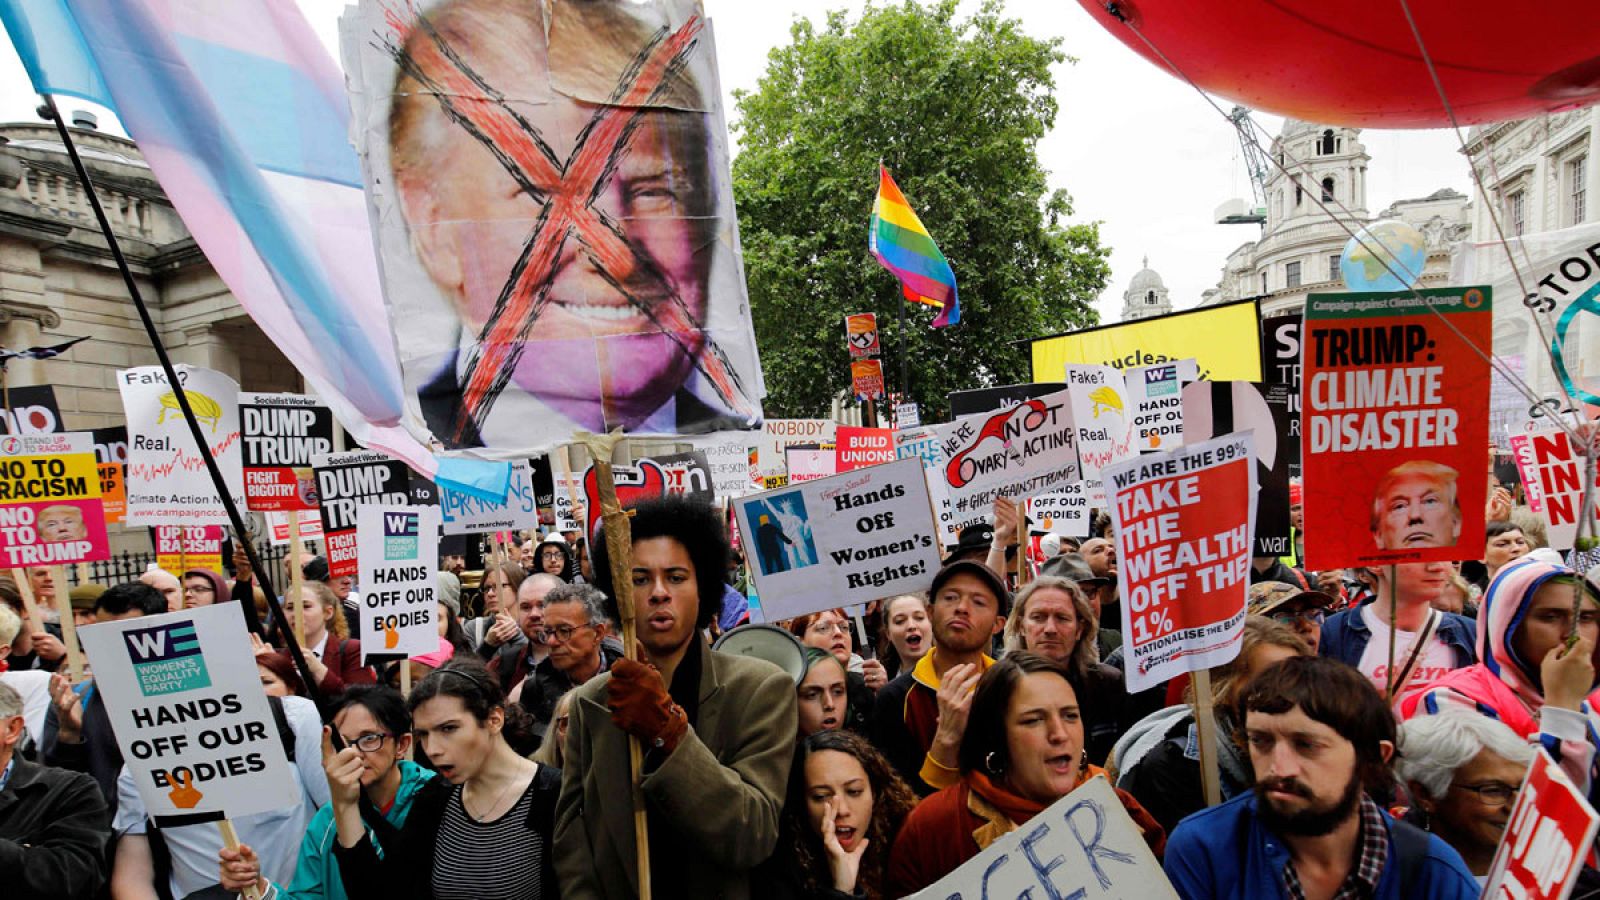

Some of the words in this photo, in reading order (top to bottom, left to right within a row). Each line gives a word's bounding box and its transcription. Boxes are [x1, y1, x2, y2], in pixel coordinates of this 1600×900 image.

[1313, 300, 1354, 312] Campaign
[1354, 299, 1388, 311] against
[1389, 297, 1425, 307] Climate
[1426, 295, 1462, 306] Change
[1312, 325, 1436, 368] TRUMP:
[1103, 349, 1178, 369] uclea
[125, 371, 188, 386] Fak?
[1069, 370, 1105, 385] Fake?
[1310, 366, 1443, 410] CLIMATE
[254, 396, 288, 405] Socialist
[289, 397, 316, 406] Worker
[1139, 398, 1183, 412] HAND
[243, 408, 316, 437] DUMP
[1134, 414, 1161, 426] OFF
[1165, 411, 1183, 422] OU
[766, 422, 825, 436] NOBODY
[1080, 428, 1112, 441] Real.
[1140, 423, 1183, 438] BODIE
[1310, 408, 1458, 454] DISASTER
[38, 444, 72, 452] RACISM
[134, 434, 176, 451] Real.
[850, 436, 887, 448] BUILD
[941, 421, 976, 458] WE'RE
[244, 437, 331, 465] TRUMP
[327, 456, 361, 466] Socialist
[361, 453, 389, 463] Worker
[841, 451, 895, 463] UNIONS
[0, 460, 26, 480] NO
[31, 459, 66, 478] TO
[1113, 469, 1137, 489] WE
[1140, 459, 1177, 479] ARE
[1180, 451, 1214, 472] THE
[1216, 441, 1248, 463] 99%
[246, 471, 280, 484] FIGHT
[318, 465, 392, 500] DUMP
[765, 477, 777, 486] NO
[1086, 479, 1104, 488] Clim
[0, 477, 89, 500] RACISM
[247, 484, 296, 497] BIGOTRY
[440, 474, 534, 522] LIBRNS
[833, 483, 905, 512] Hands
[1117, 476, 1201, 521] TAKE
[129, 494, 167, 505] Climate
[170, 494, 208, 504] Action
[213, 495, 243, 505] Nw!
[1034, 498, 1056, 508] OFF
[1059, 497, 1087, 507] OUR
[0, 506, 35, 527] NO
[134, 509, 229, 518] www.campaigncc.o
[322, 492, 408, 529] TRP
[1036, 510, 1081, 520] BODIES
[386, 514, 418, 533] WE
[478, 519, 516, 530] marching!
[856, 511, 896, 534] Off
[0, 526, 36, 546] TO
[159, 527, 182, 540] UP
[184, 527, 206, 540] TO
[1121, 513, 1180, 553] THE
[4, 540, 92, 564] TRUMP
[159, 540, 220, 553] RACISM
[331, 549, 357, 563] BIGO
[830, 533, 933, 567] Women's
[1126, 524, 1247, 583] WEALTH
[373, 566, 427, 584] HANDS
[846, 559, 927, 589] Rights!
[1130, 573, 1187, 613] OFF
[1196, 558, 1248, 595] THE
[366, 591, 401, 609] OFF
[406, 587, 434, 604] OUR
[374, 610, 430, 632] BODIES
[1133, 607, 1173, 641] 1%
[128, 626, 202, 659] WE
[1134, 628, 1205, 658] NATIONALISE
[1206, 624, 1223, 635] THE
[137, 659, 197, 676] WOMEN'S
[141, 667, 202, 684] EQUALITY
[1373, 664, 1452, 680] COBYN
[131, 693, 243, 729] HANDS
[131, 735, 189, 760] OFF
[198, 721, 269, 751] OUR
[150, 753, 267, 789] BODIES
